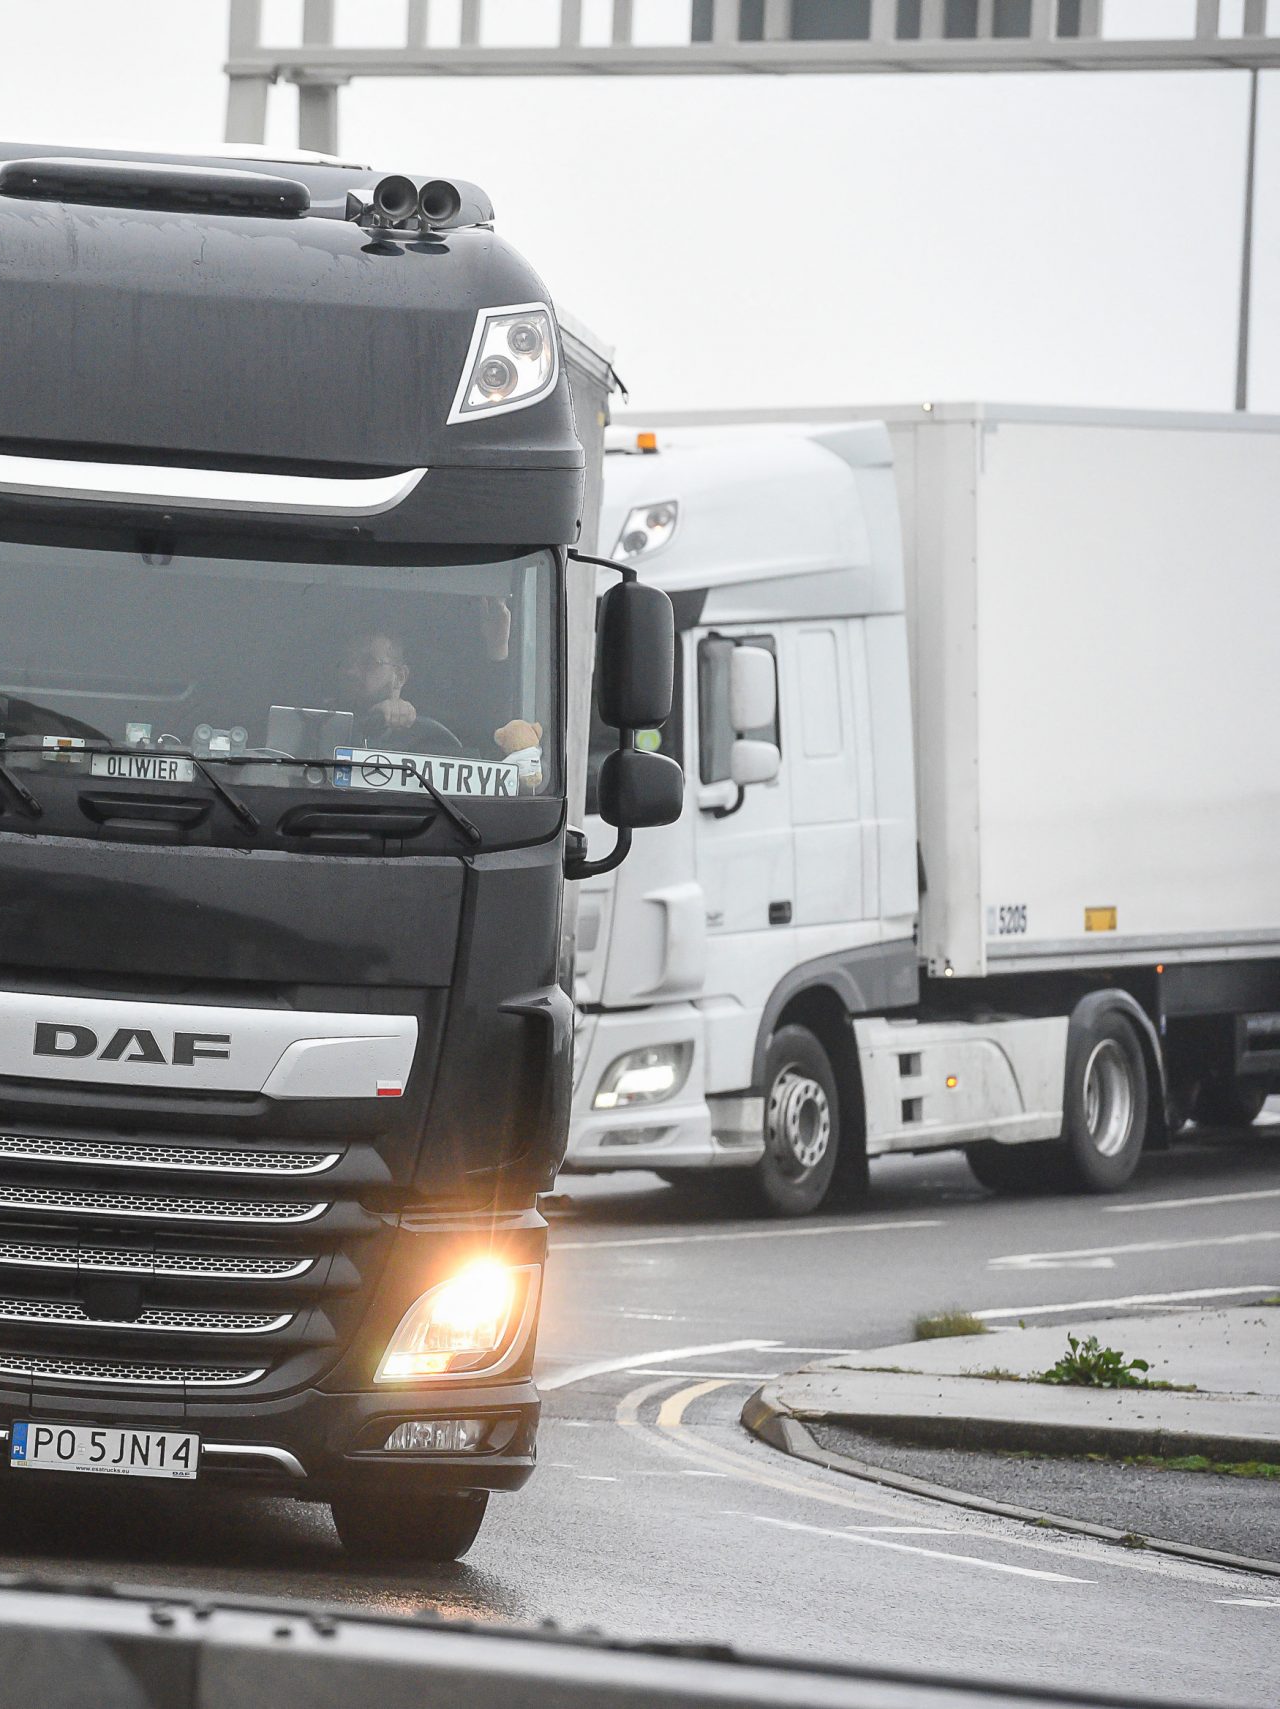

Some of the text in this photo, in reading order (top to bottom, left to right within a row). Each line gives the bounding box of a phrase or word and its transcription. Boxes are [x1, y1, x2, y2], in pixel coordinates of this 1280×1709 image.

[106, 756, 179, 781] OLIWIER
[336, 771, 349, 782] PL
[401, 758, 512, 797] PATRYK
[33, 1021, 232, 1067] DAF
[13, 1445, 25, 1455] PL
[33, 1427, 191, 1469] PO 5JN14
